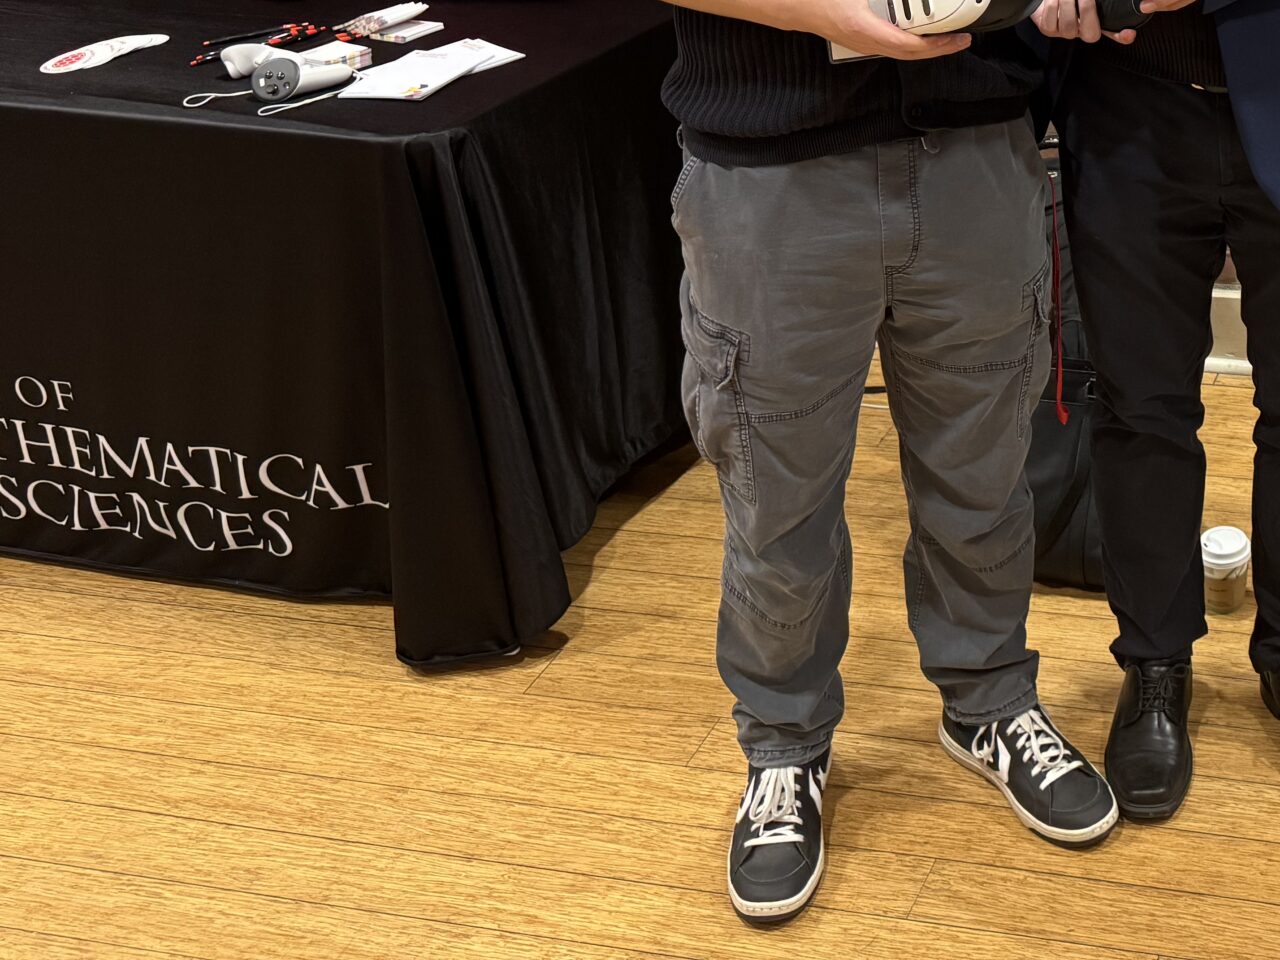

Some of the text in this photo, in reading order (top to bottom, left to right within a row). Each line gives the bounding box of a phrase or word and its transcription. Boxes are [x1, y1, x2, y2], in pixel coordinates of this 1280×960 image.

[14, 375, 74, 411] OF
[0, 417, 390, 510] HEMATICAL
[0, 474, 293, 557] SCIENCES
